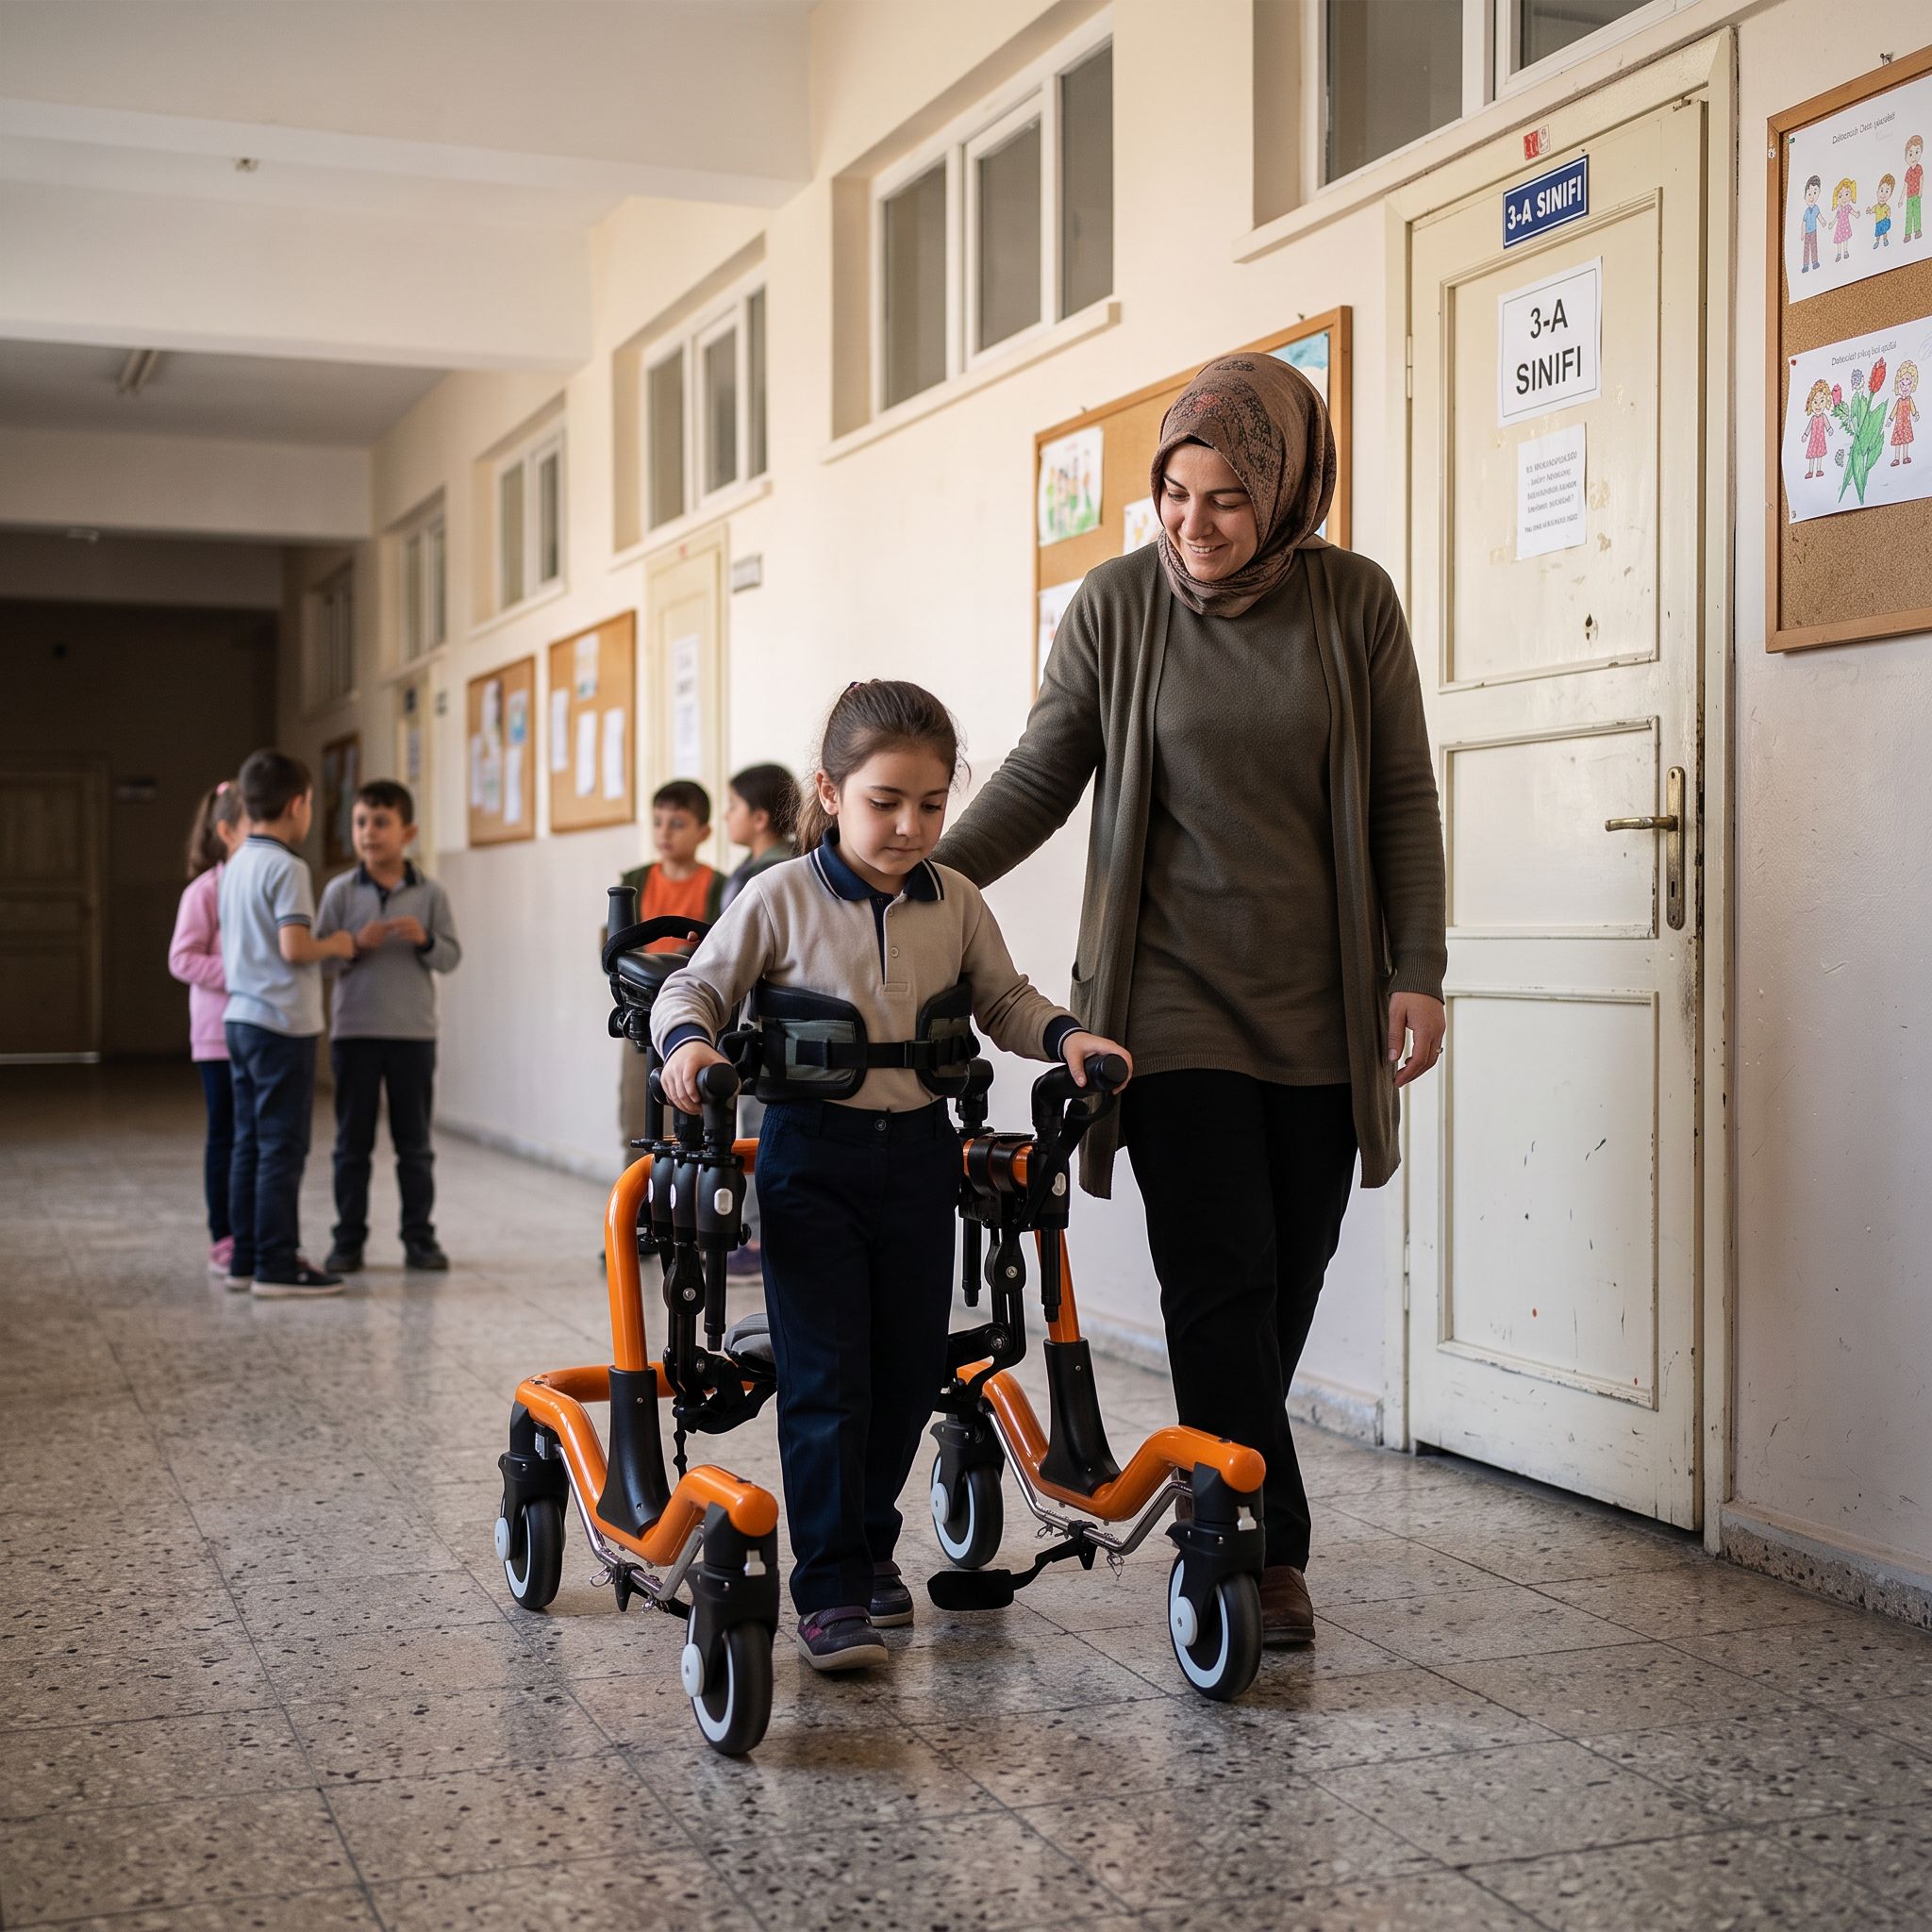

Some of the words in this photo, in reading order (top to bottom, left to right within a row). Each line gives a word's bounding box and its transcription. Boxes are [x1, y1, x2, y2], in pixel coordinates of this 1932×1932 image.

[1507, 198, 1533, 230] 3-A
[1537, 175, 1582, 218] SINIFI
[1530, 298, 1568, 339] 3-A
[1516, 345, 1581, 395] SINIFI
